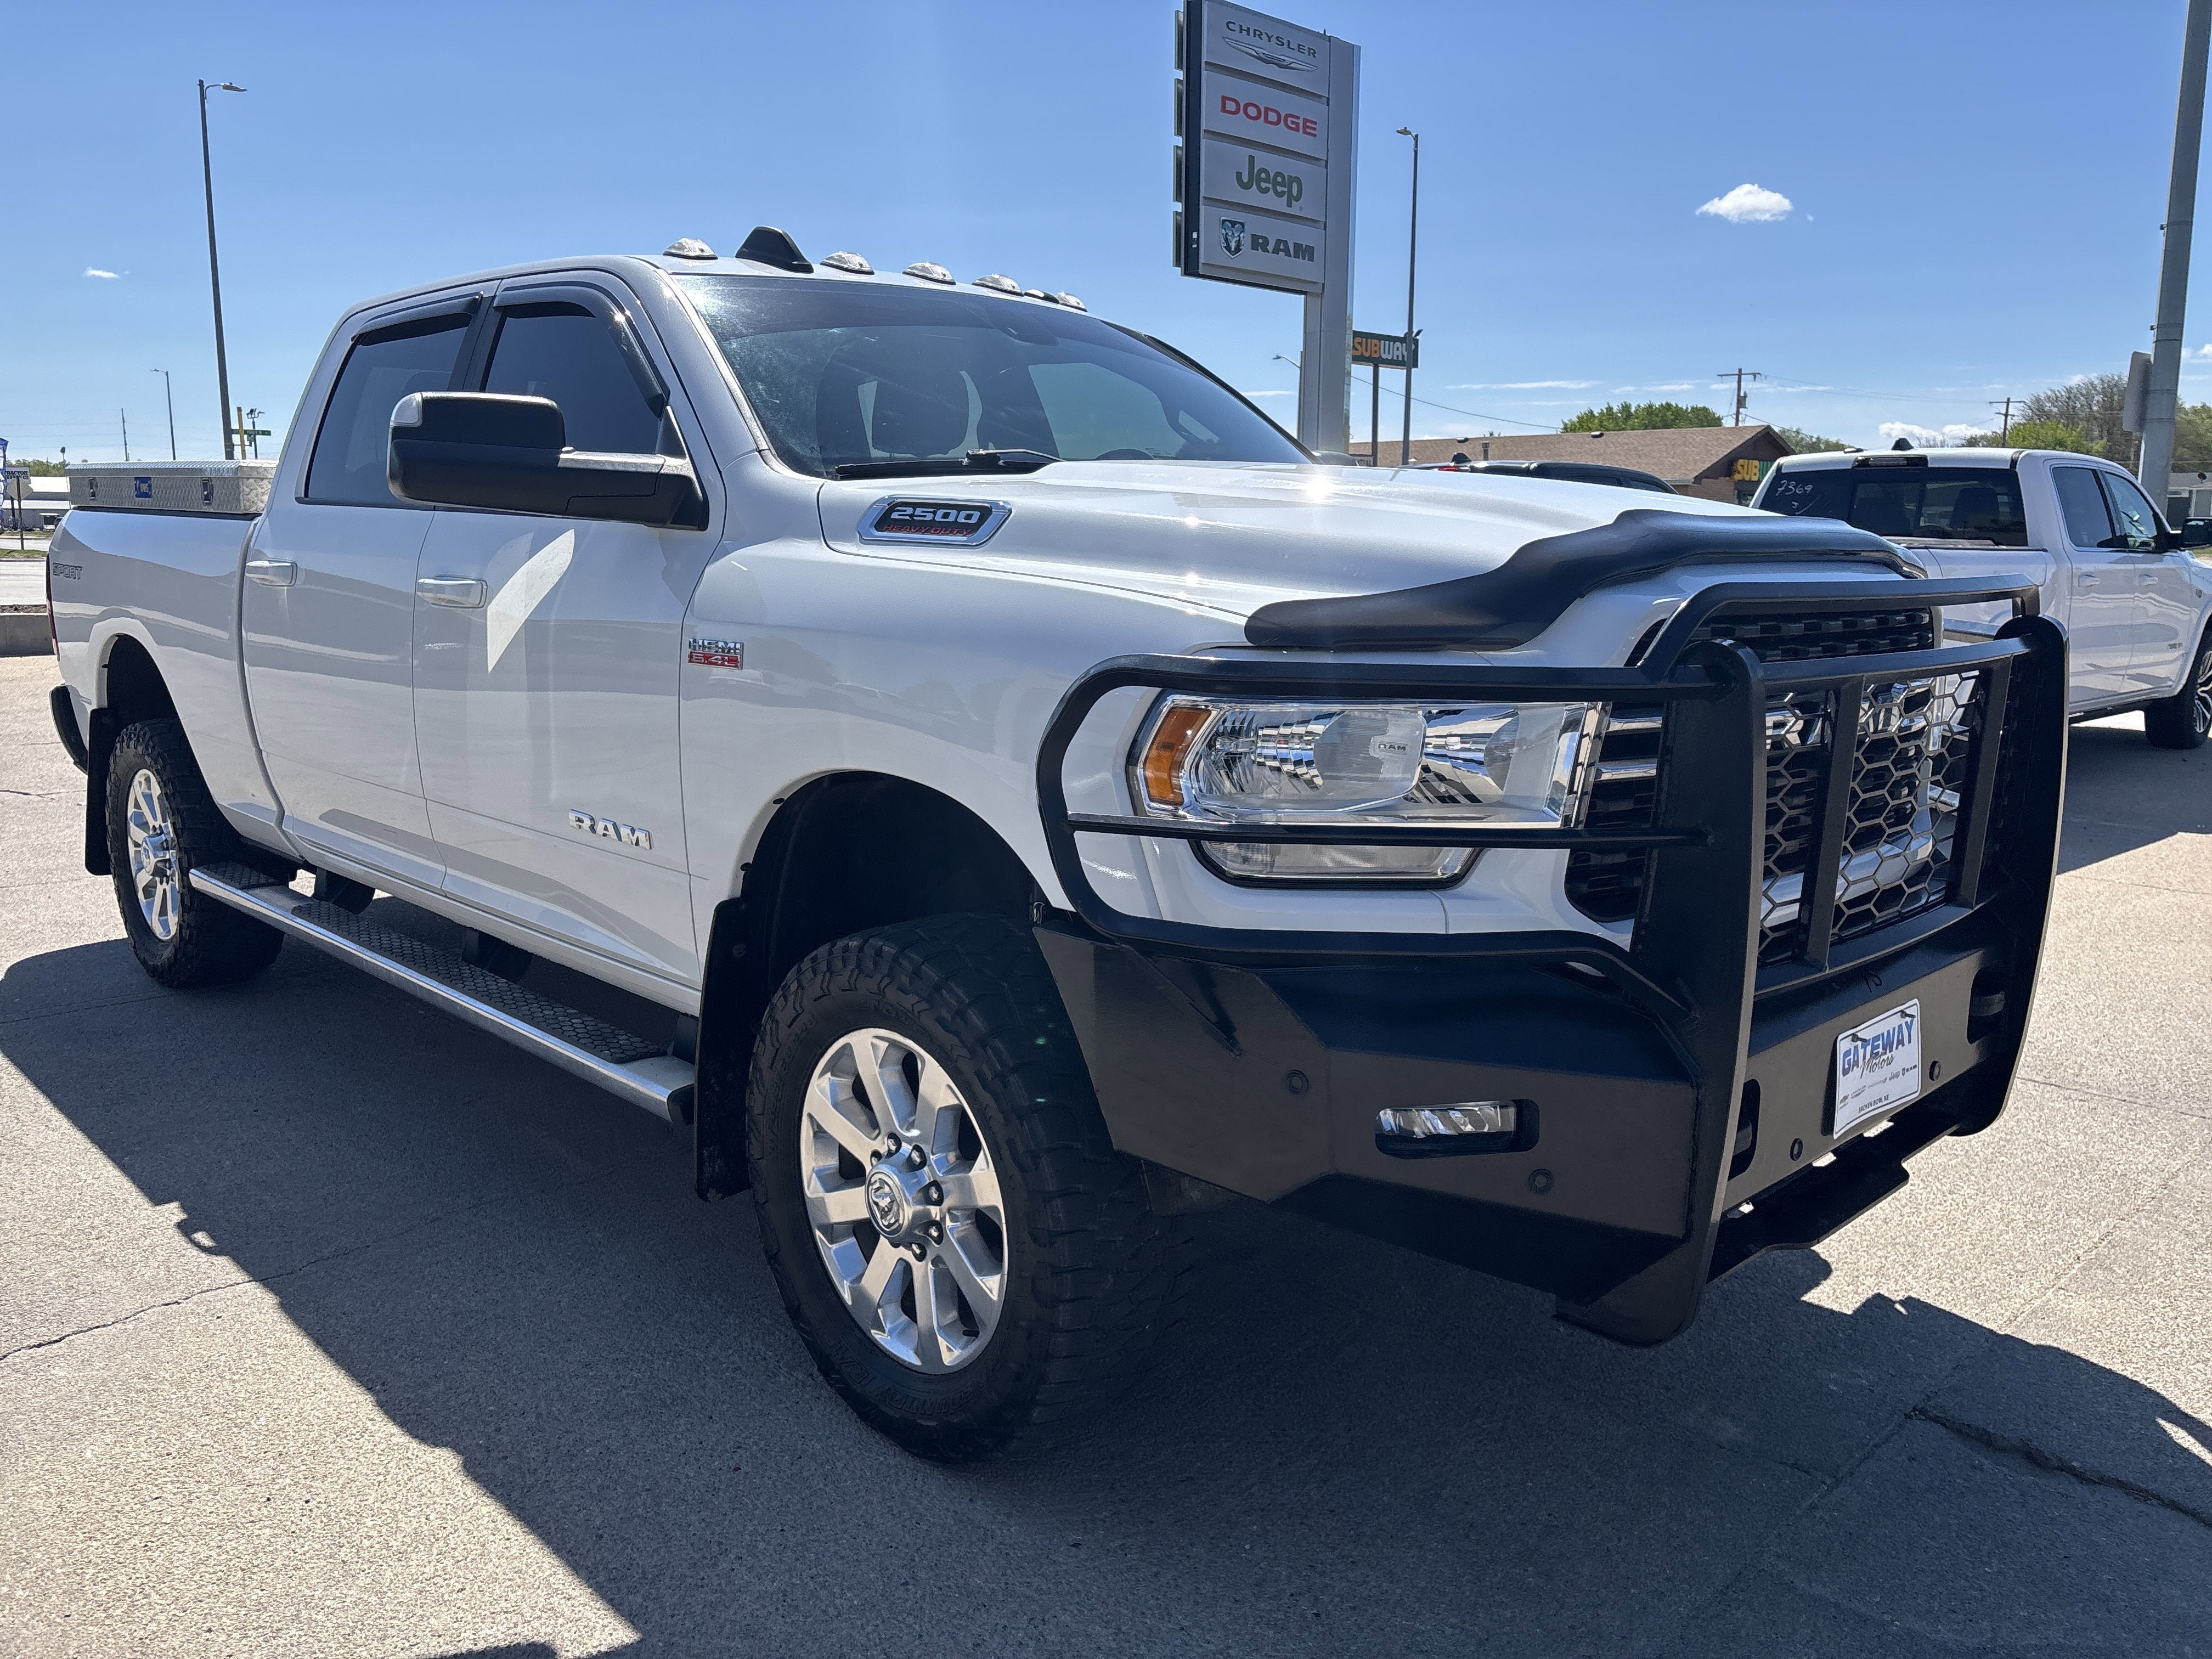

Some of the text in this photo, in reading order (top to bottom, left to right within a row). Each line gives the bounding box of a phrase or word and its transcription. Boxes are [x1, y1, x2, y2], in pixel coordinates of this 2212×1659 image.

[1226, 21, 1317, 59] CHRYSLER
[1220, 95, 1318, 138] DODGE
[1235, 155, 1304, 208] Jeep
[1250, 233, 1315, 263] RAM
[1775, 479, 1813, 496] 7369
[890, 506, 981, 523] 2500
[883, 524, 972, 535] HEAVY DUTY
[53, 562, 83, 580] SPORT
[689, 638, 741, 654] HEMI
[569, 809, 652, 850] RAM
[1842, 1019, 1915, 1077] GATEWAY
[1860, 1050, 1895, 1079] Motors
